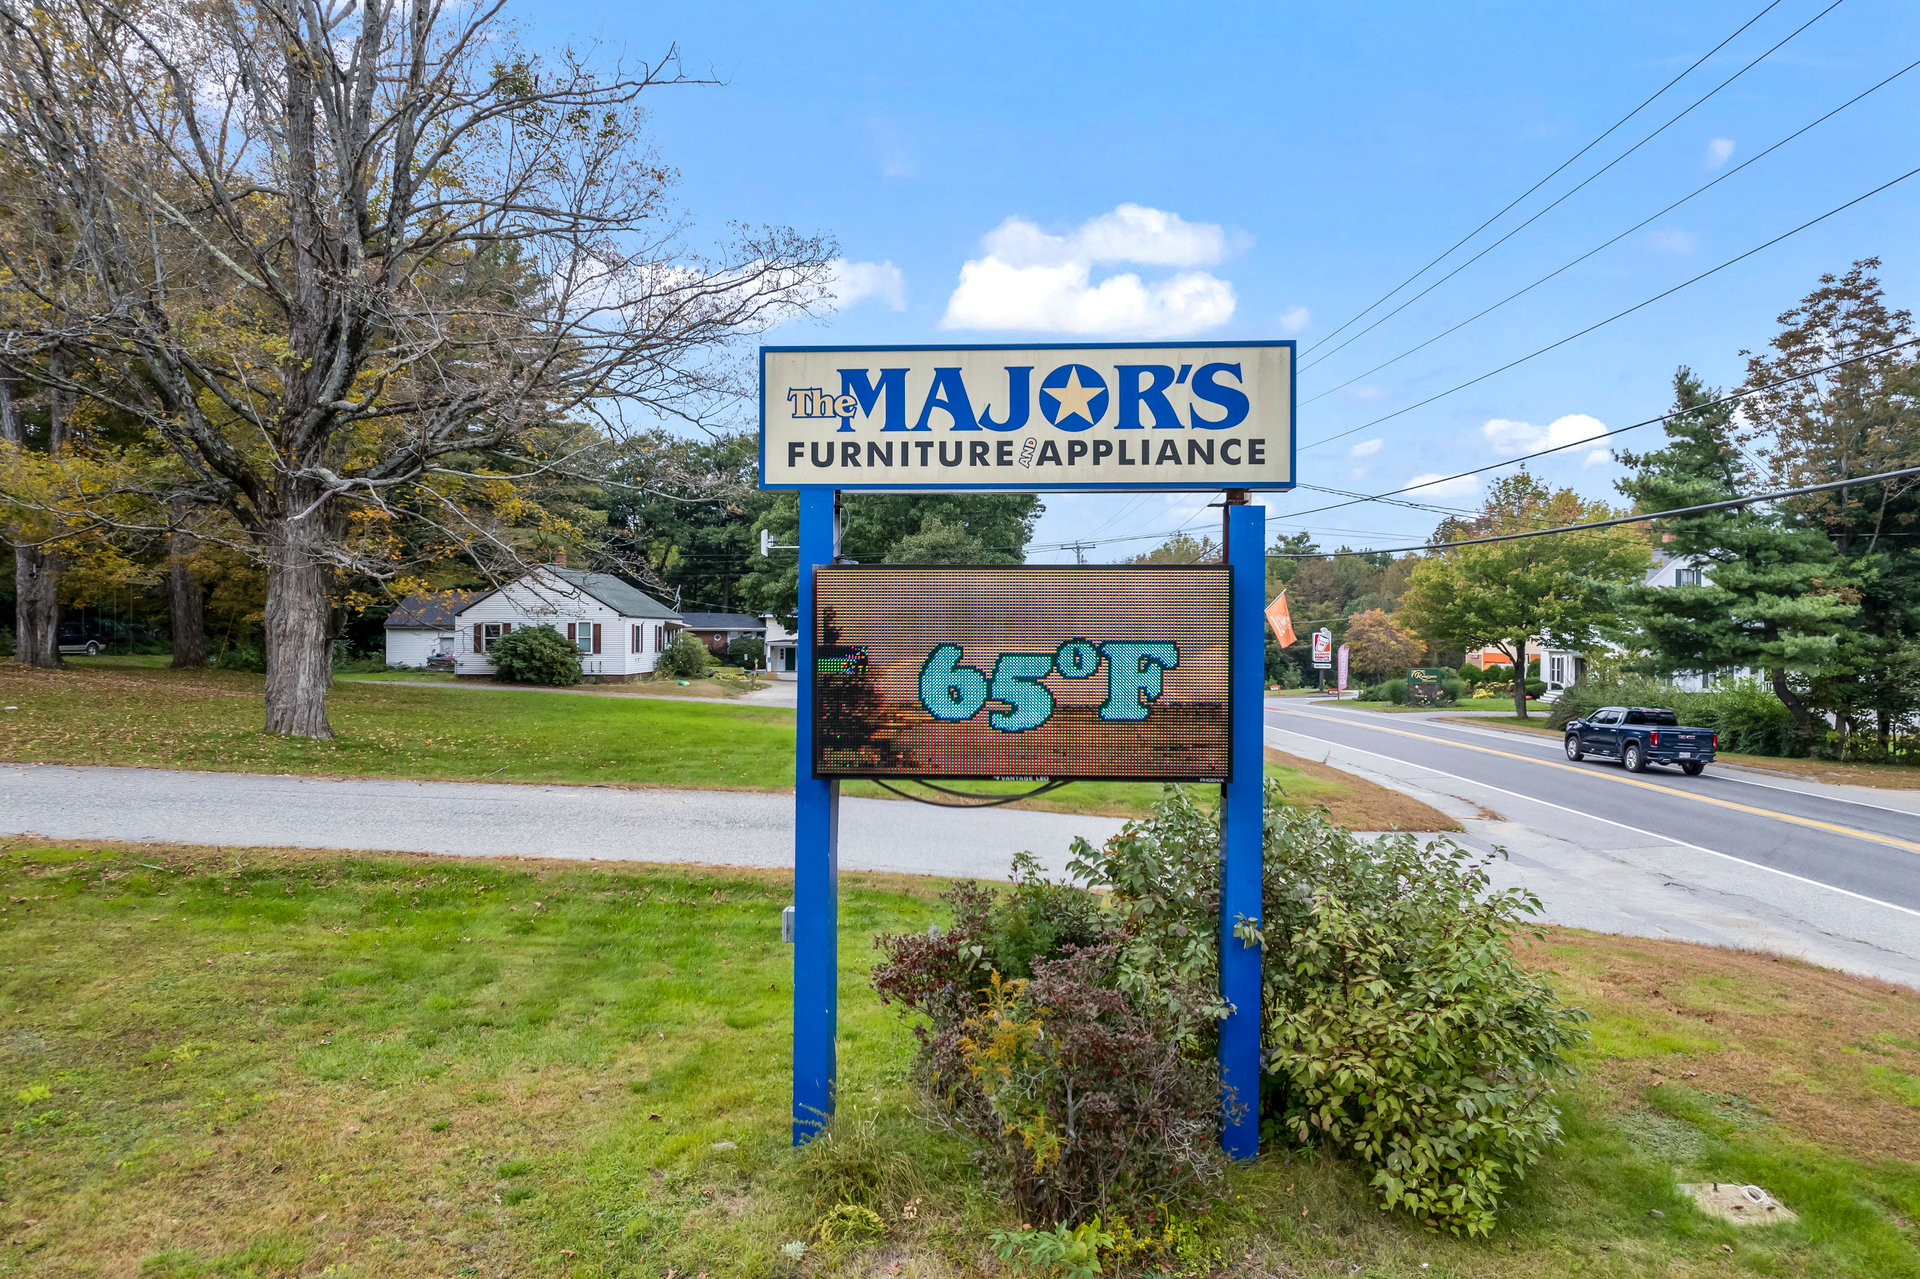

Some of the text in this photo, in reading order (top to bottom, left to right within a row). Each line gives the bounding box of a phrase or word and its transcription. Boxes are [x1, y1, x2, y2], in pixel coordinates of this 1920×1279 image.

[787, 387, 858, 419] The
[788, 437, 1266, 469] FURNITURE AND APPLIANCE
